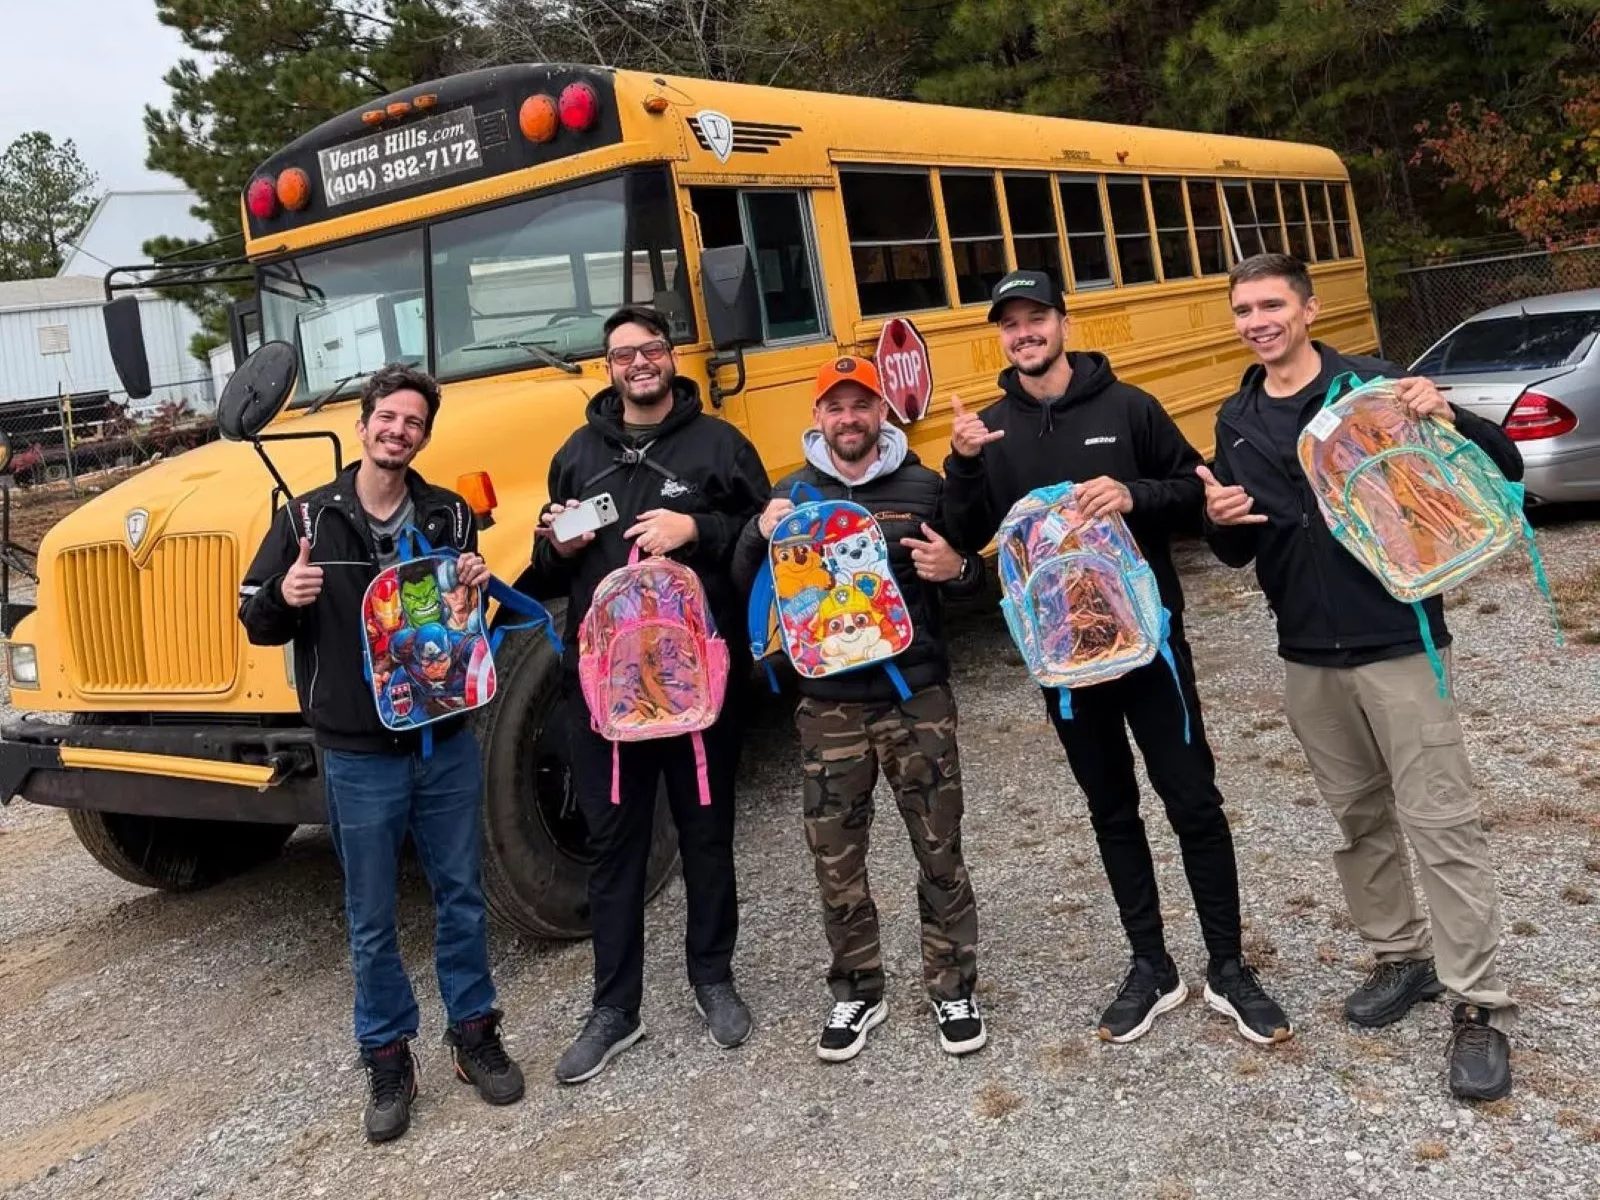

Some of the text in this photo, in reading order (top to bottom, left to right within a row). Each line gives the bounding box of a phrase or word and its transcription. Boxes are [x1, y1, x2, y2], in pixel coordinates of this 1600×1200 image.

[326, 139, 480, 201] (404) 382-7172
[329, 122, 465, 172] Verna Hills.com
[885, 350, 922, 391] STOP
